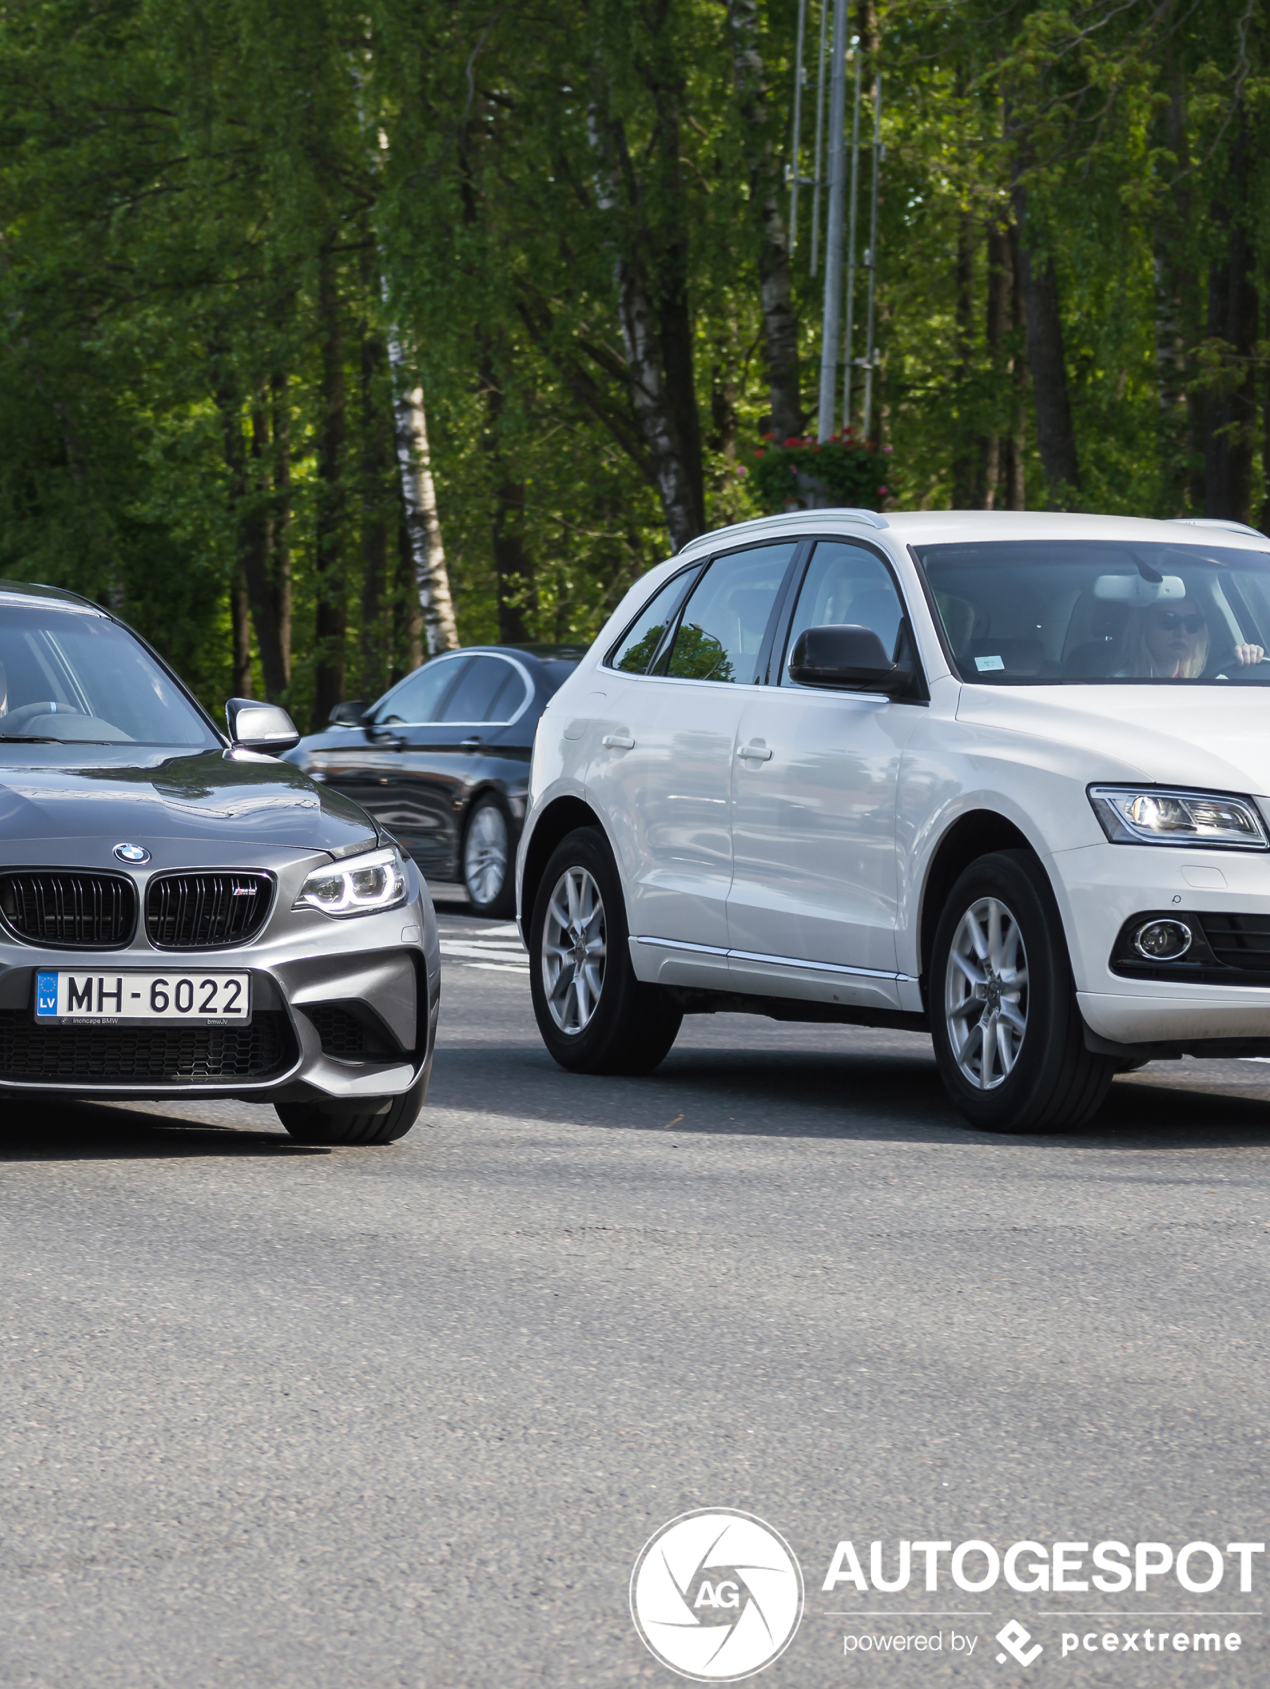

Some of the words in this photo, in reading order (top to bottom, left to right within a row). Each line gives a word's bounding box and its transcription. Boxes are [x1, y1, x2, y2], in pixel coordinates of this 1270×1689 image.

[39, 997, 55, 1009] LV
[67, 976, 242, 1014] MH-6022
[102, 1017, 119, 1025] BMW
